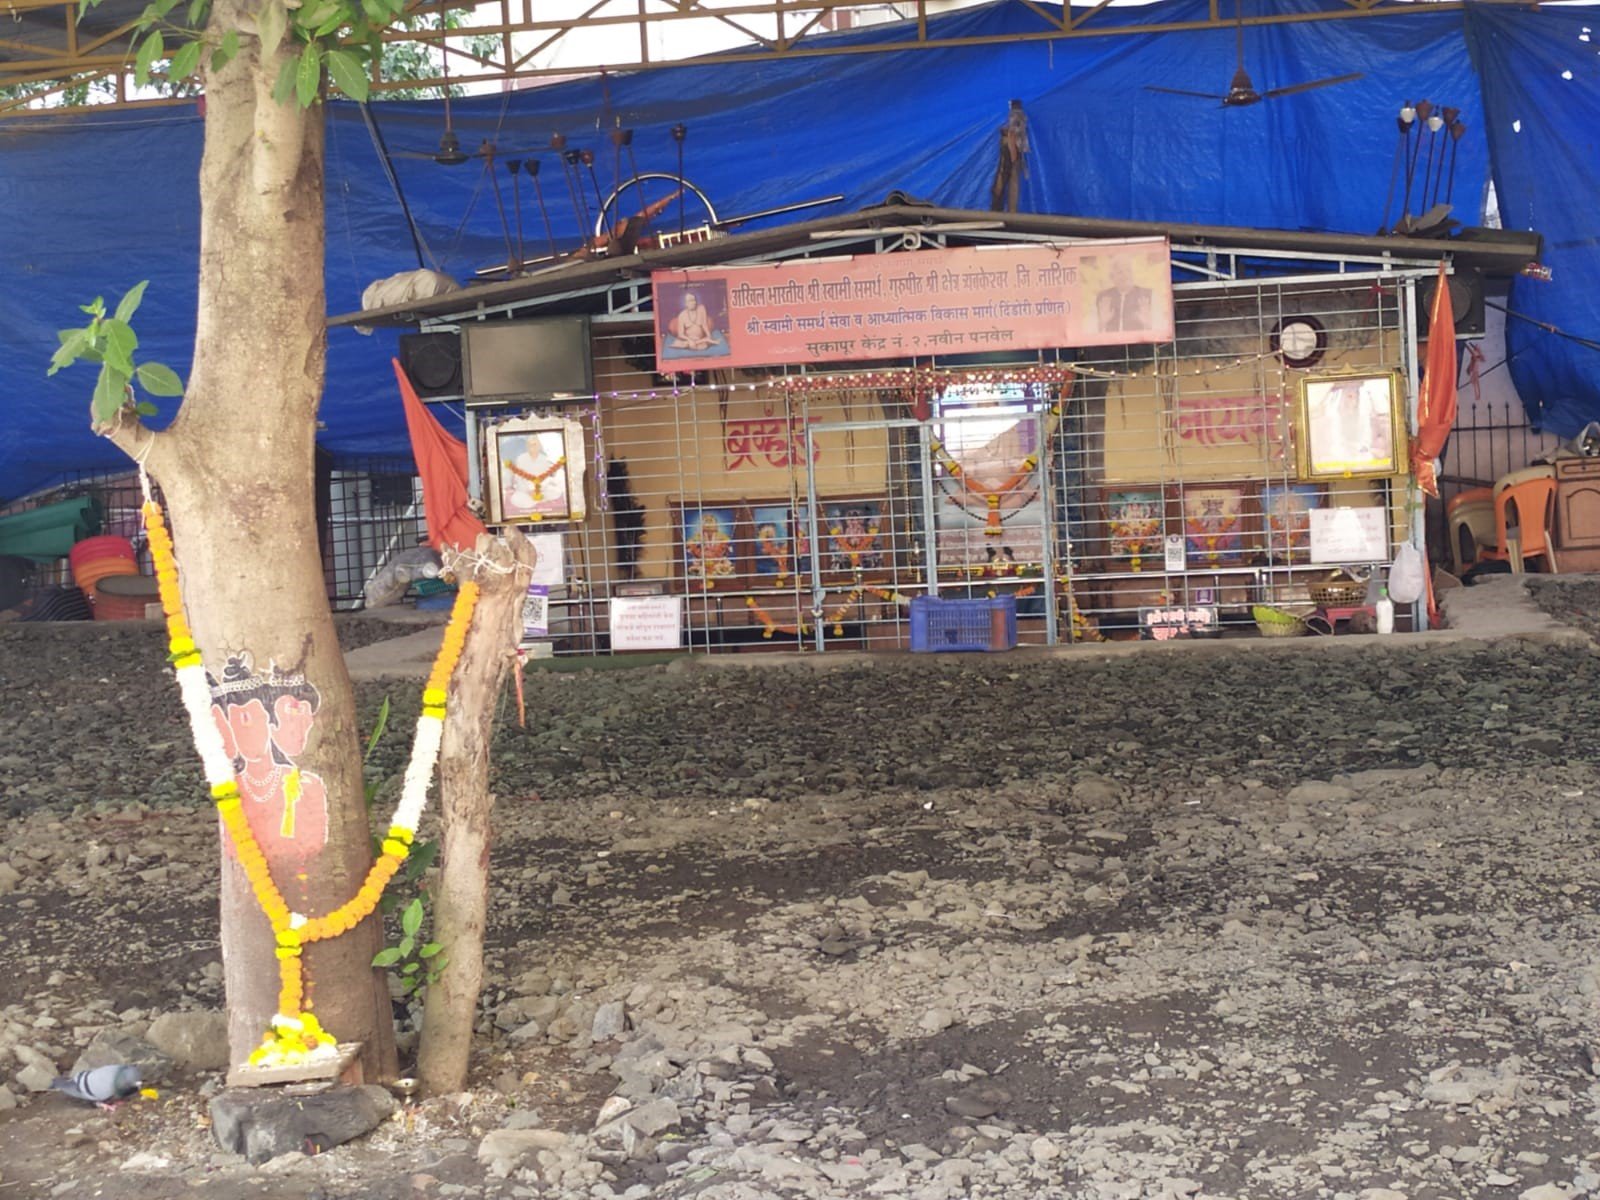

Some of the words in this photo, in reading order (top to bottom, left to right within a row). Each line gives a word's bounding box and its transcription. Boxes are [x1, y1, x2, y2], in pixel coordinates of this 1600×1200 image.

[731, 283, 765, 308] अखिल
[767, 279, 804, 305] भारतीय
[806, 278, 819, 302] श्री
[821, 275, 851, 300] स्वामी
[926, 270, 939, 293] श्री
[942, 268, 960, 292] क्षेत्र
[746, 316, 760, 333] श्री
[762, 314, 793, 331] स्वामी
[795, 310, 825, 329] समर्थ
[827, 311, 850, 327] सेवा
[853, 313, 862, 325] व
[867, 306, 927, 325] आध्यात्मिक
[930, 304, 969, 321] विकास
[805, 339, 857, 357] सुकापूर
[860, 334, 887, 351] केंद्र
[967, 326, 1015, 343] पनवेल
